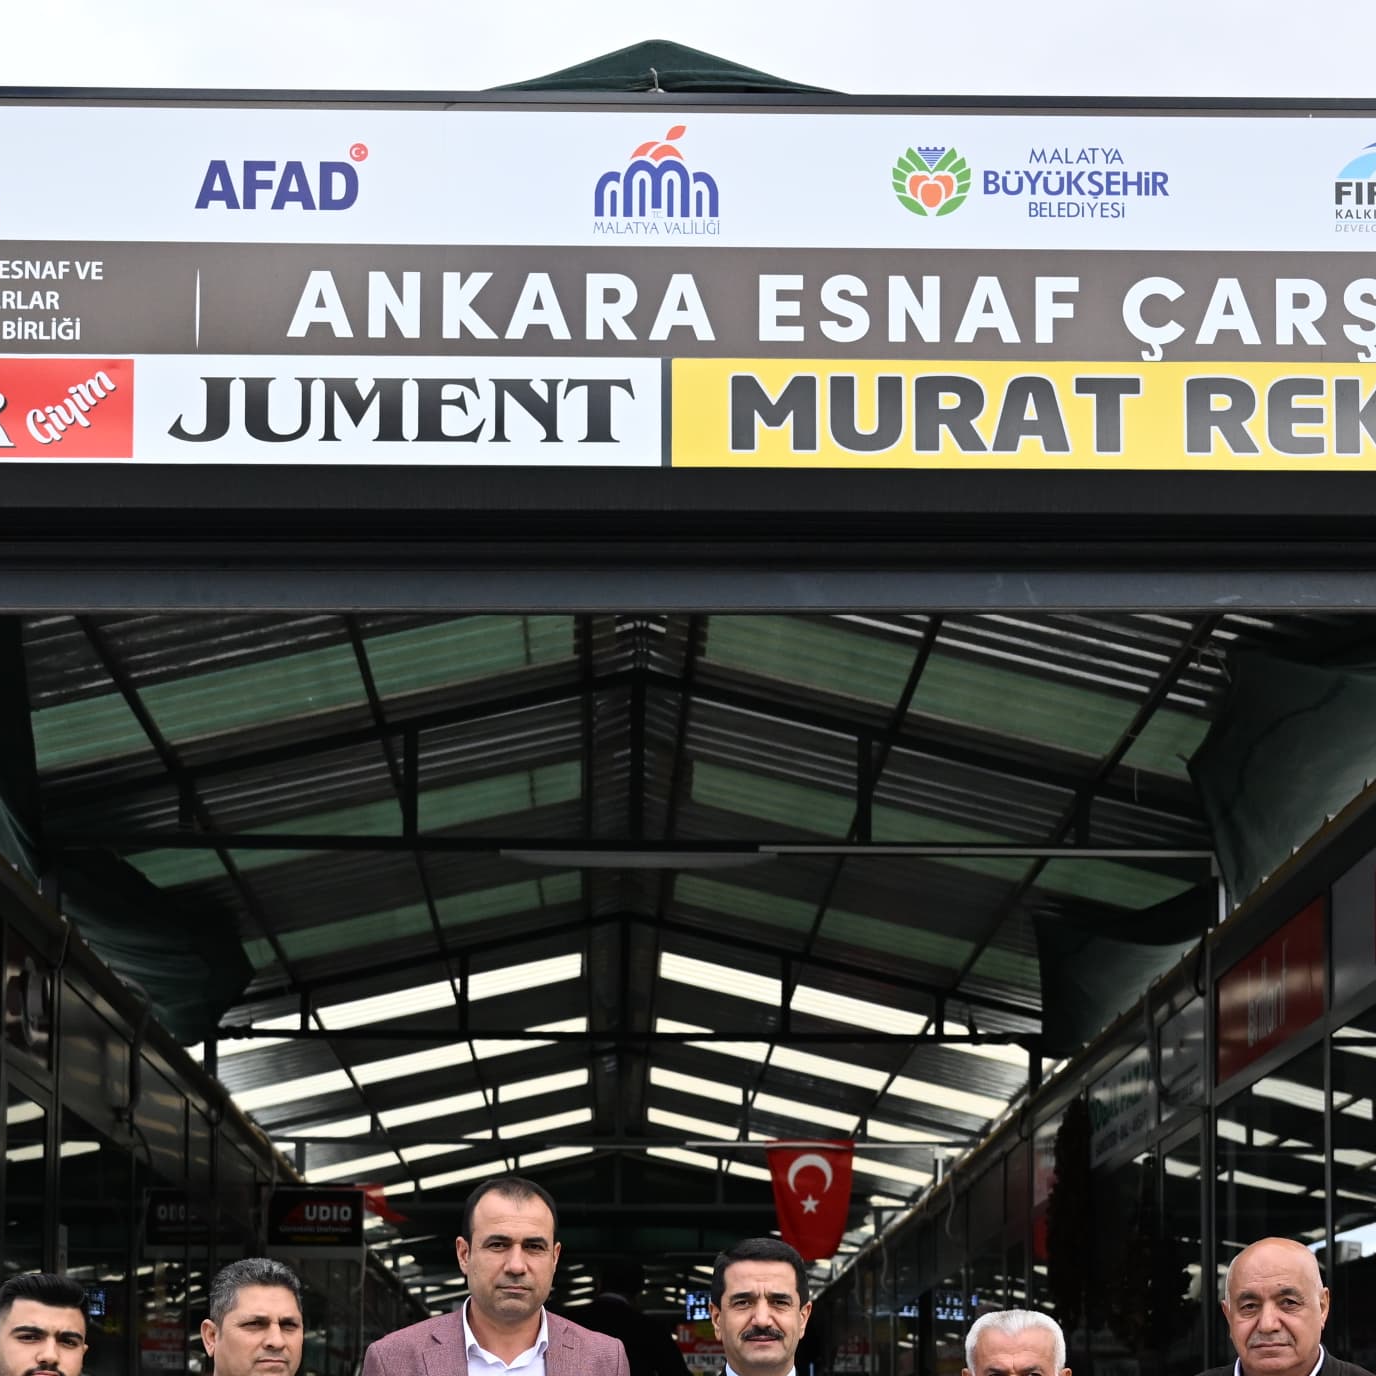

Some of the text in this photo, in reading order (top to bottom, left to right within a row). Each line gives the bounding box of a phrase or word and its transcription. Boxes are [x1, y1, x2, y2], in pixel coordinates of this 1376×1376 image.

[1028, 147, 1124, 165] MALATYA
[194, 159, 359, 211] AFAD
[592, 220, 659, 235] MALATYA
[75, 262, 103, 283] VE
[2, 315, 81, 342] BİRLİĞİ
[286, 268, 716, 342] ANKARA
[757, 275, 1081, 346] ESNAF
[24, 368, 117, 446] Giyim
[168, 375, 635, 444] JUMENT
[729, 371, 1142, 455] MURAT
